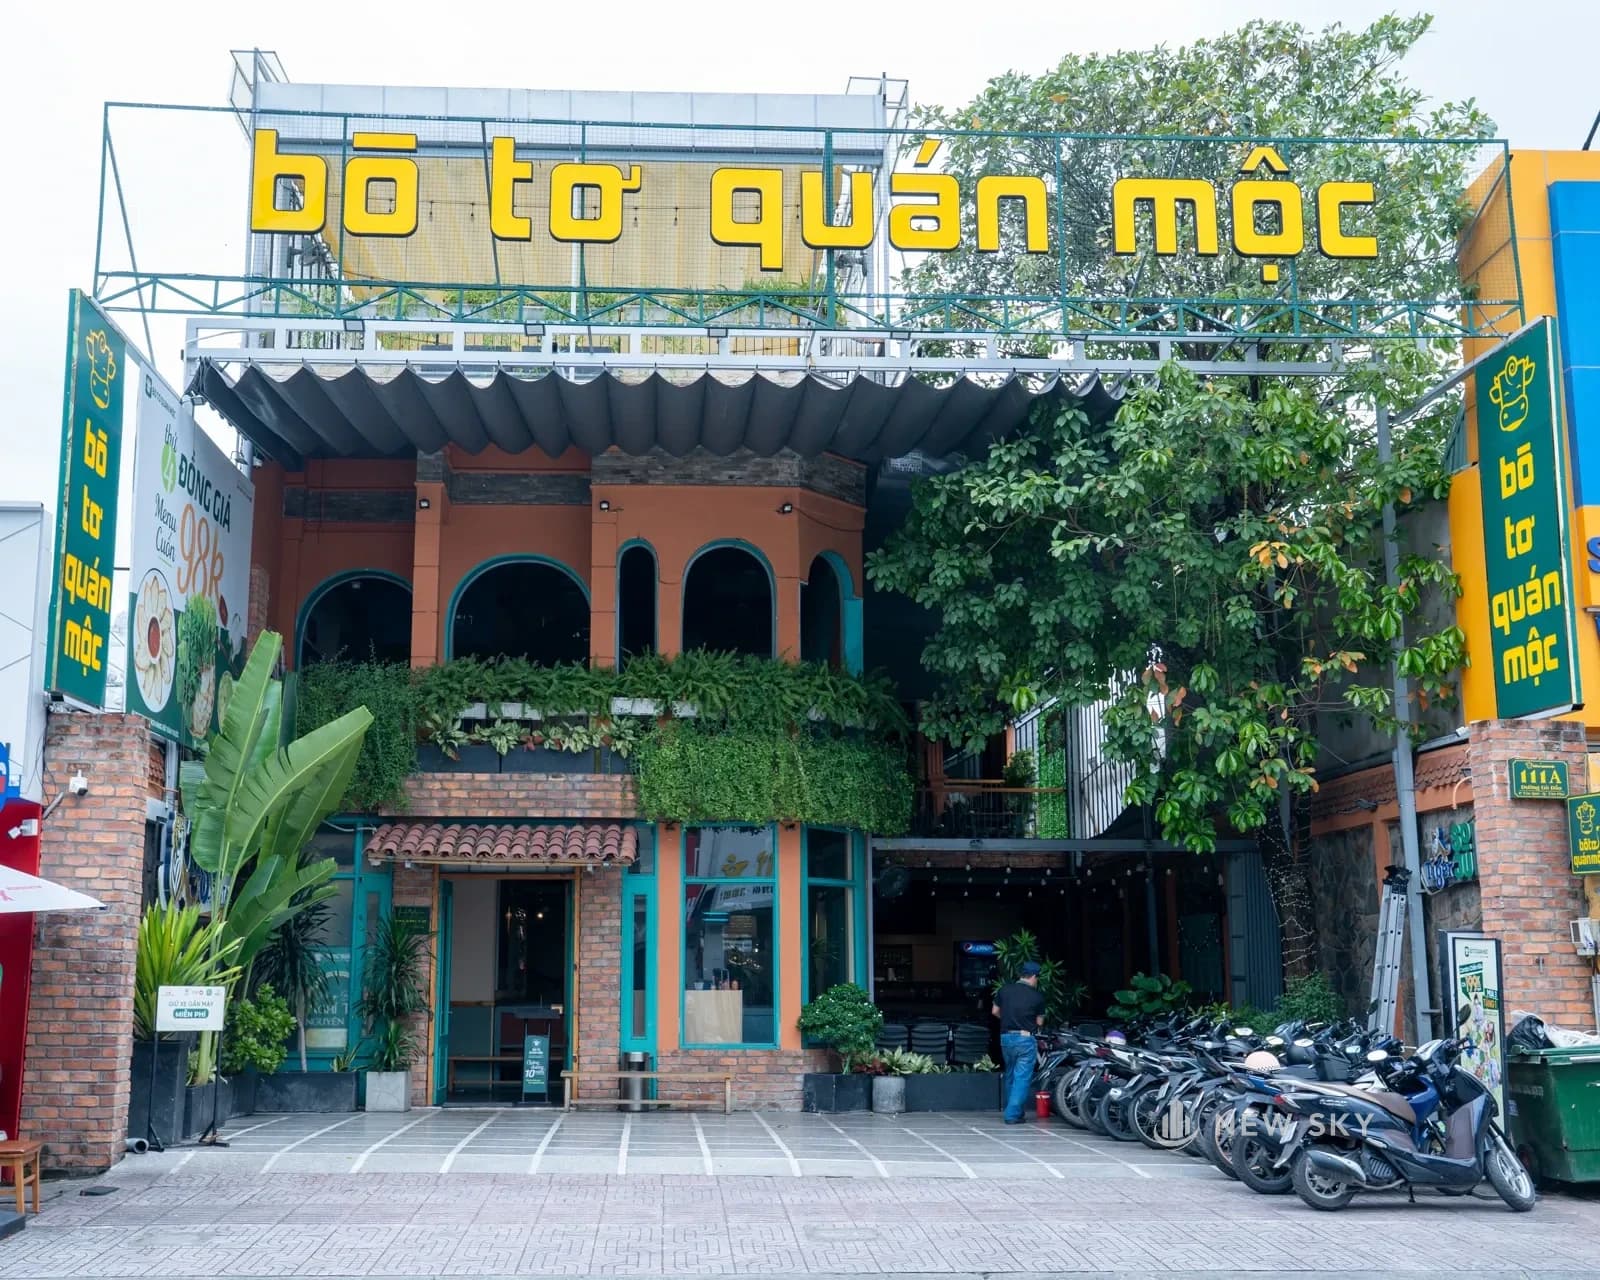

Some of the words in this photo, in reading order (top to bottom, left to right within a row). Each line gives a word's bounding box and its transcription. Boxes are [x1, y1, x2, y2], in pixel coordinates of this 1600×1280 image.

[489, 136, 642, 242] tơ
[709, 139, 1050, 272] quán
[1112, 146, 1379, 284] mộc
[81, 484, 104, 541] tơ
[155, 493, 177, 533] Menu
[213, 490, 231, 534] GIÁ
[1504, 515, 1535, 560] tơ
[64, 556, 111, 614] quán
[1492, 564, 1561, 636] quán
[63, 616, 103, 677] mộc
[1503, 628, 1559, 687] mộc
[1520, 769, 1563, 784] 111A
